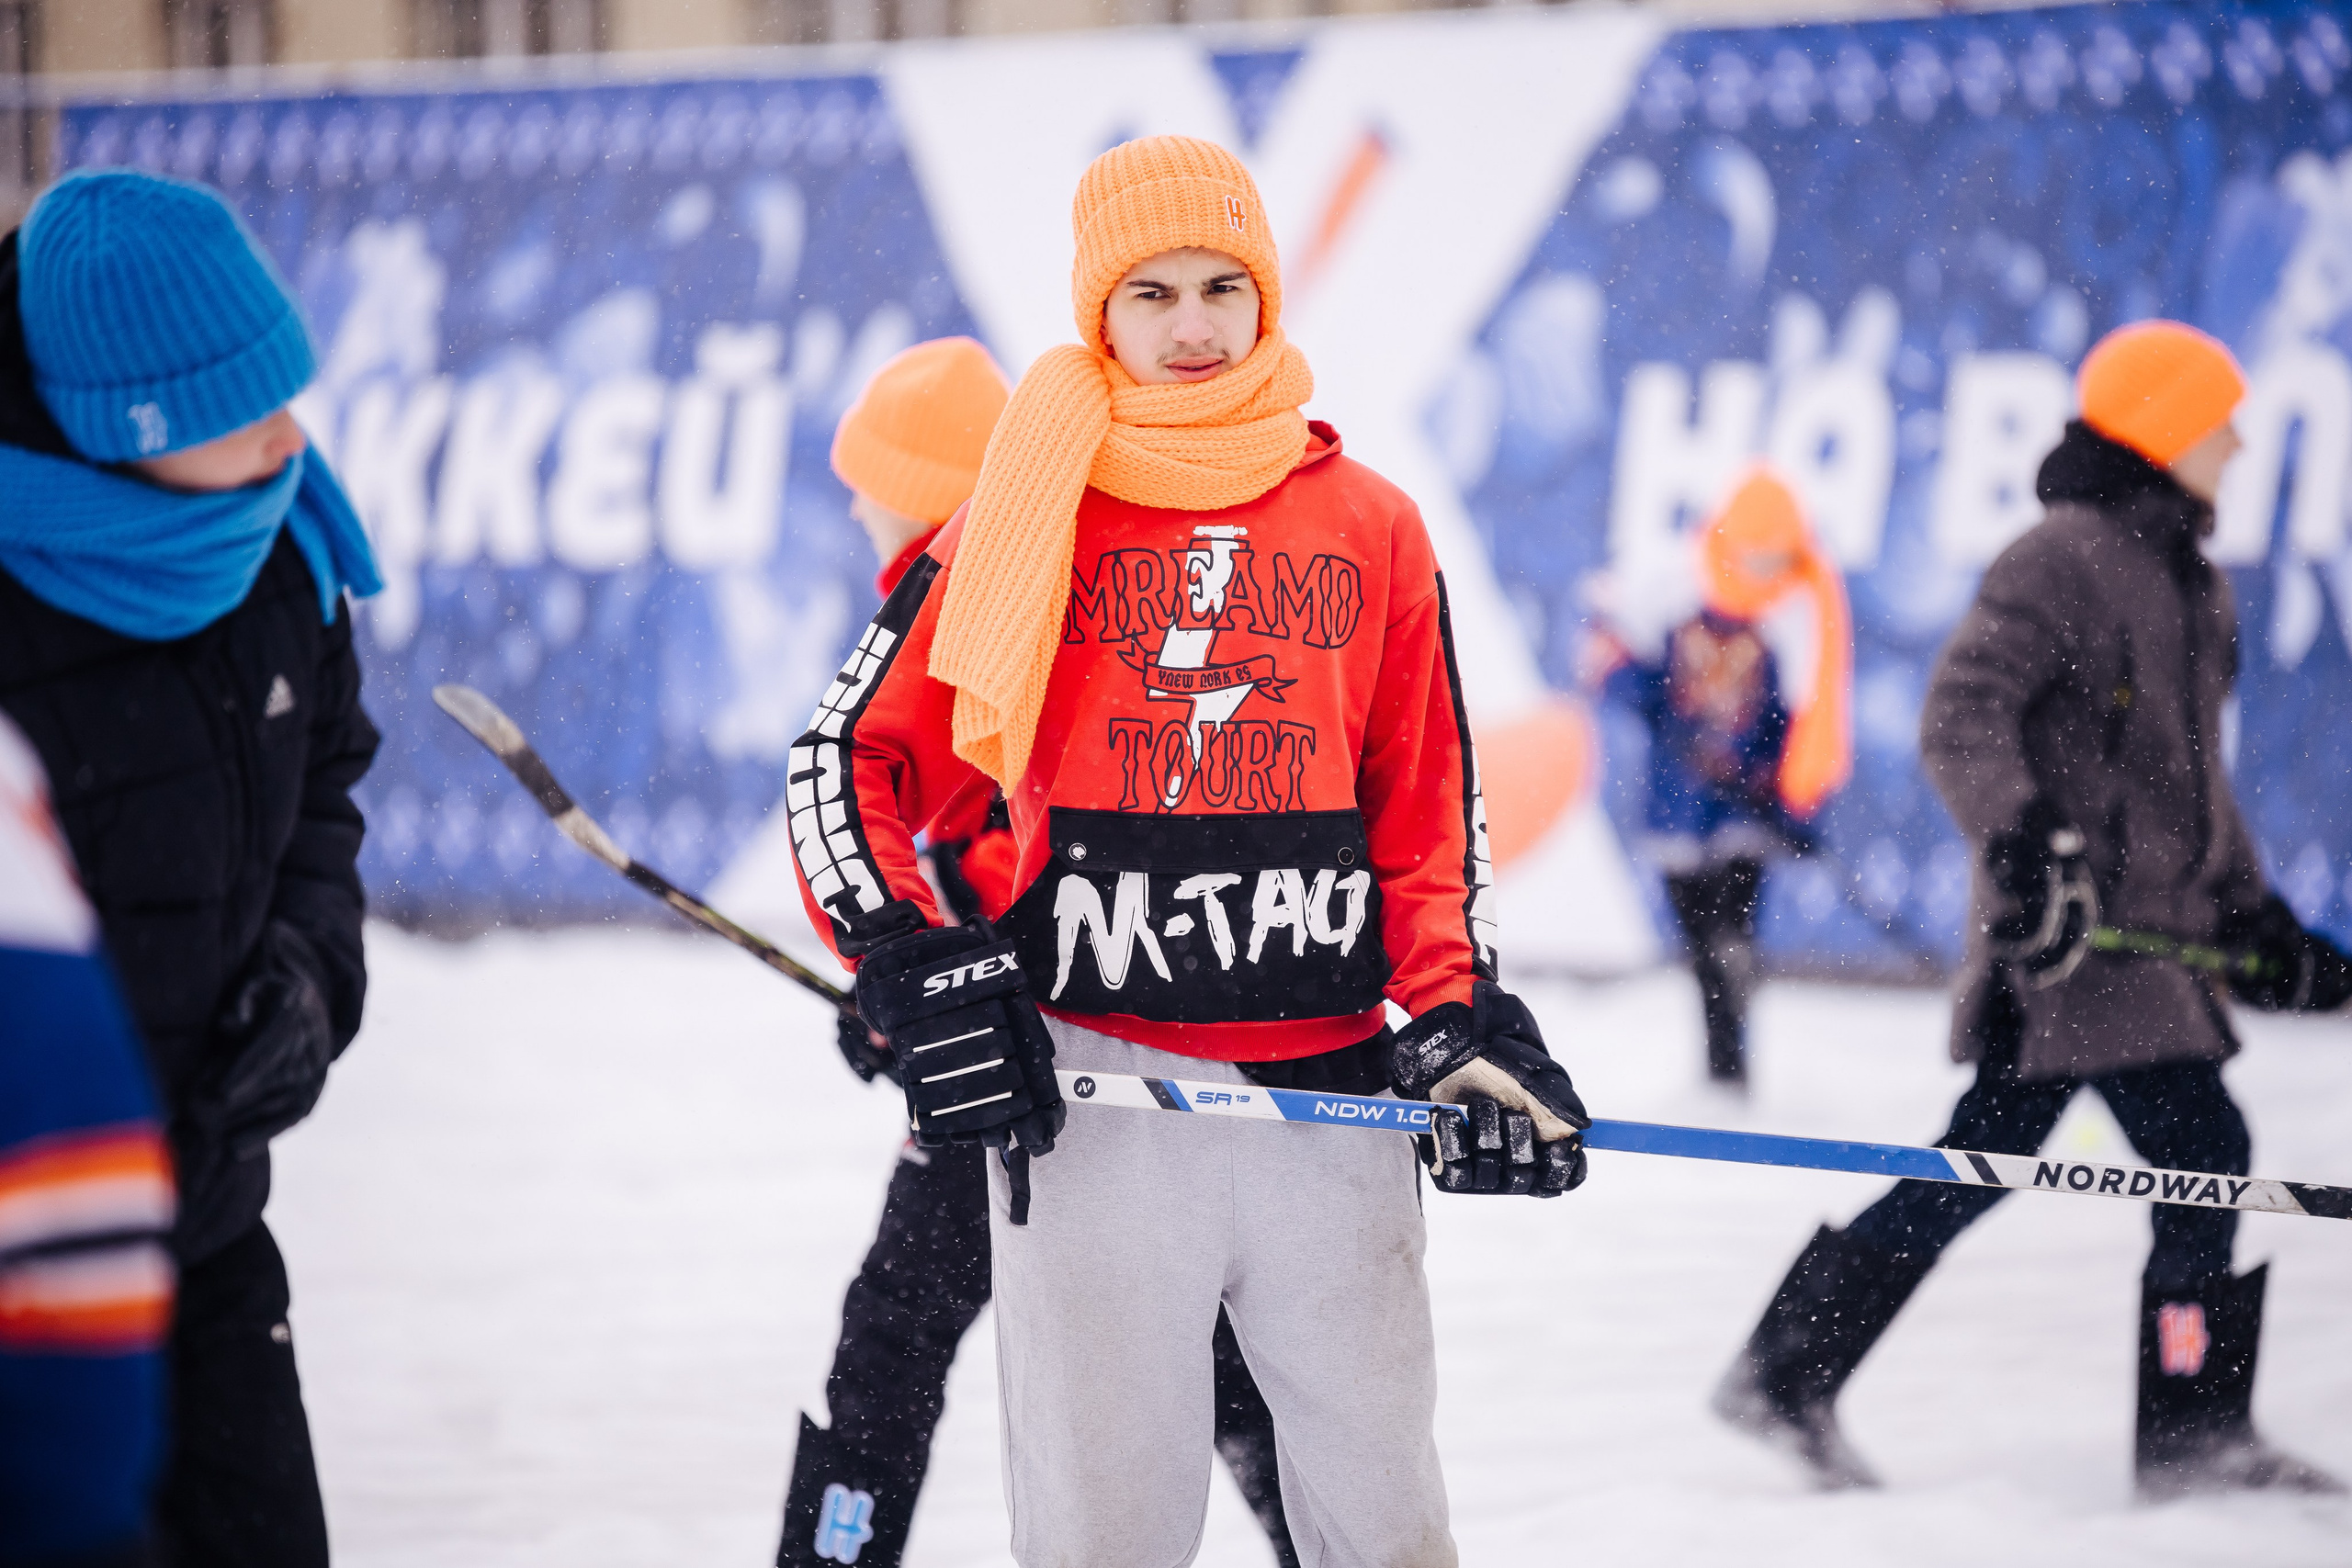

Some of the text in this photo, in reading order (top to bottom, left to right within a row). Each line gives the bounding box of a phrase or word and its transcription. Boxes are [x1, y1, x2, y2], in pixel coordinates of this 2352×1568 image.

[1108, 717, 1316, 814] TOURT
[922, 951, 1020, 998] STEX
[1418, 1029, 1449, 1056] STEX
[1195, 1090, 1251, 1106] SR 19
[1314, 1100, 1430, 1125] NDW 1.0
[2032, 1161, 2252, 1206] NORDWAY
